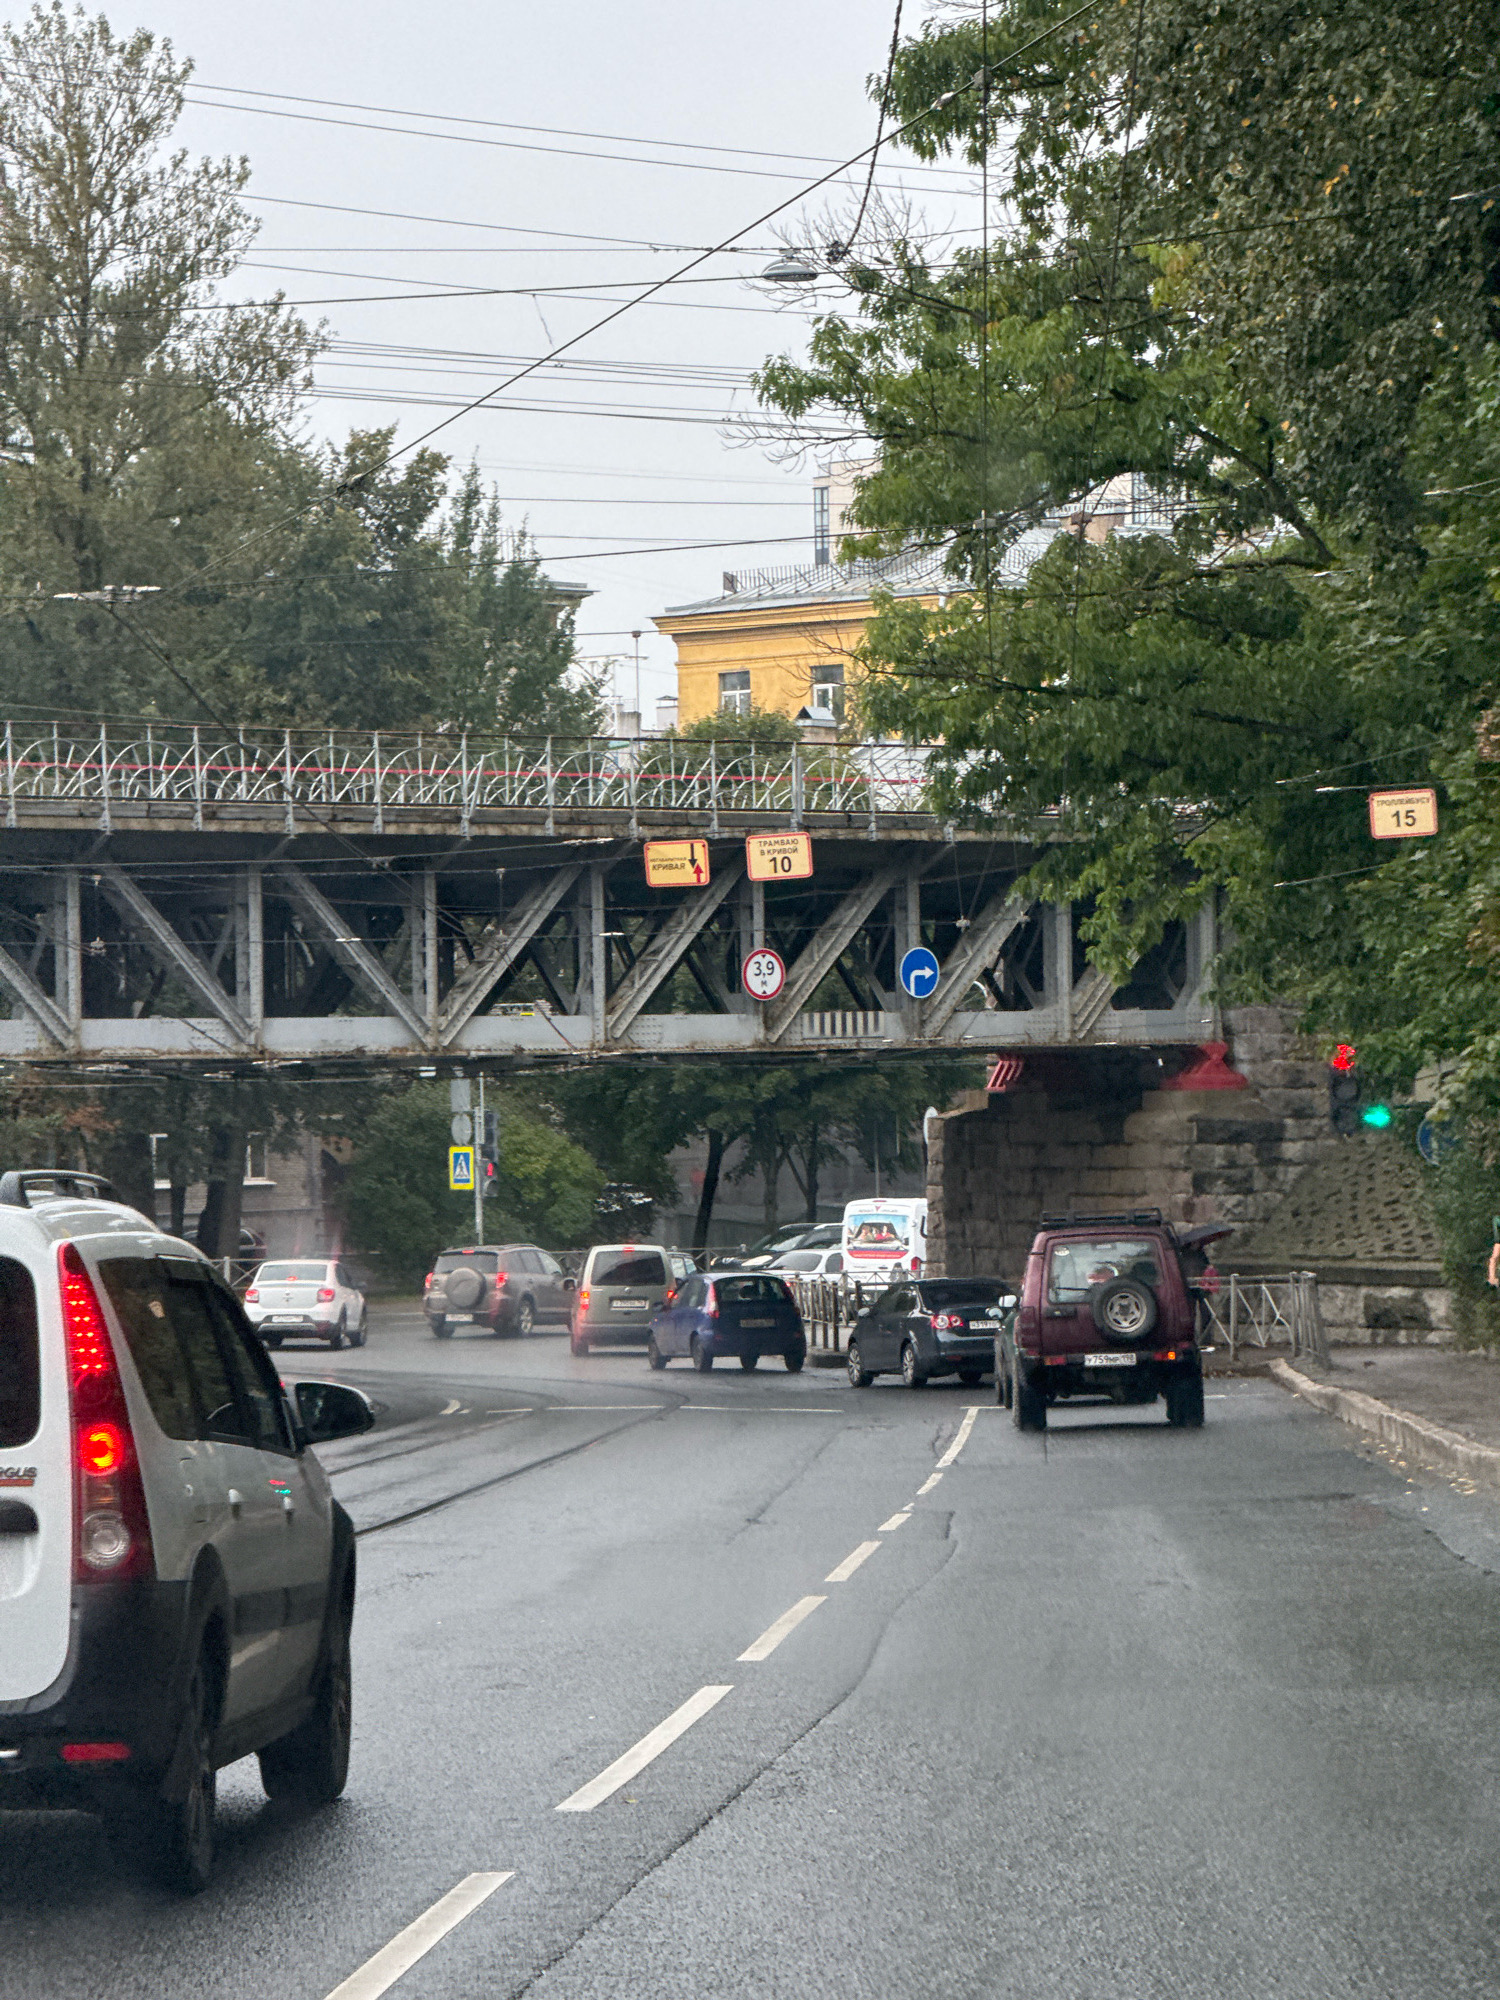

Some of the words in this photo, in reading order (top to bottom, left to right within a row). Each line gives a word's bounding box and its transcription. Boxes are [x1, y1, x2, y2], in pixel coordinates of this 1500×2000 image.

[1391, 809, 1417, 827] 15
[758, 838, 799, 847] ТРАМВАЮ
[767, 845, 799, 855] КРИВОЙ
[651, 862, 686, 871] КРИВАЯ
[769, 856, 792, 874] 10
[753, 960, 775, 978] 3,9
